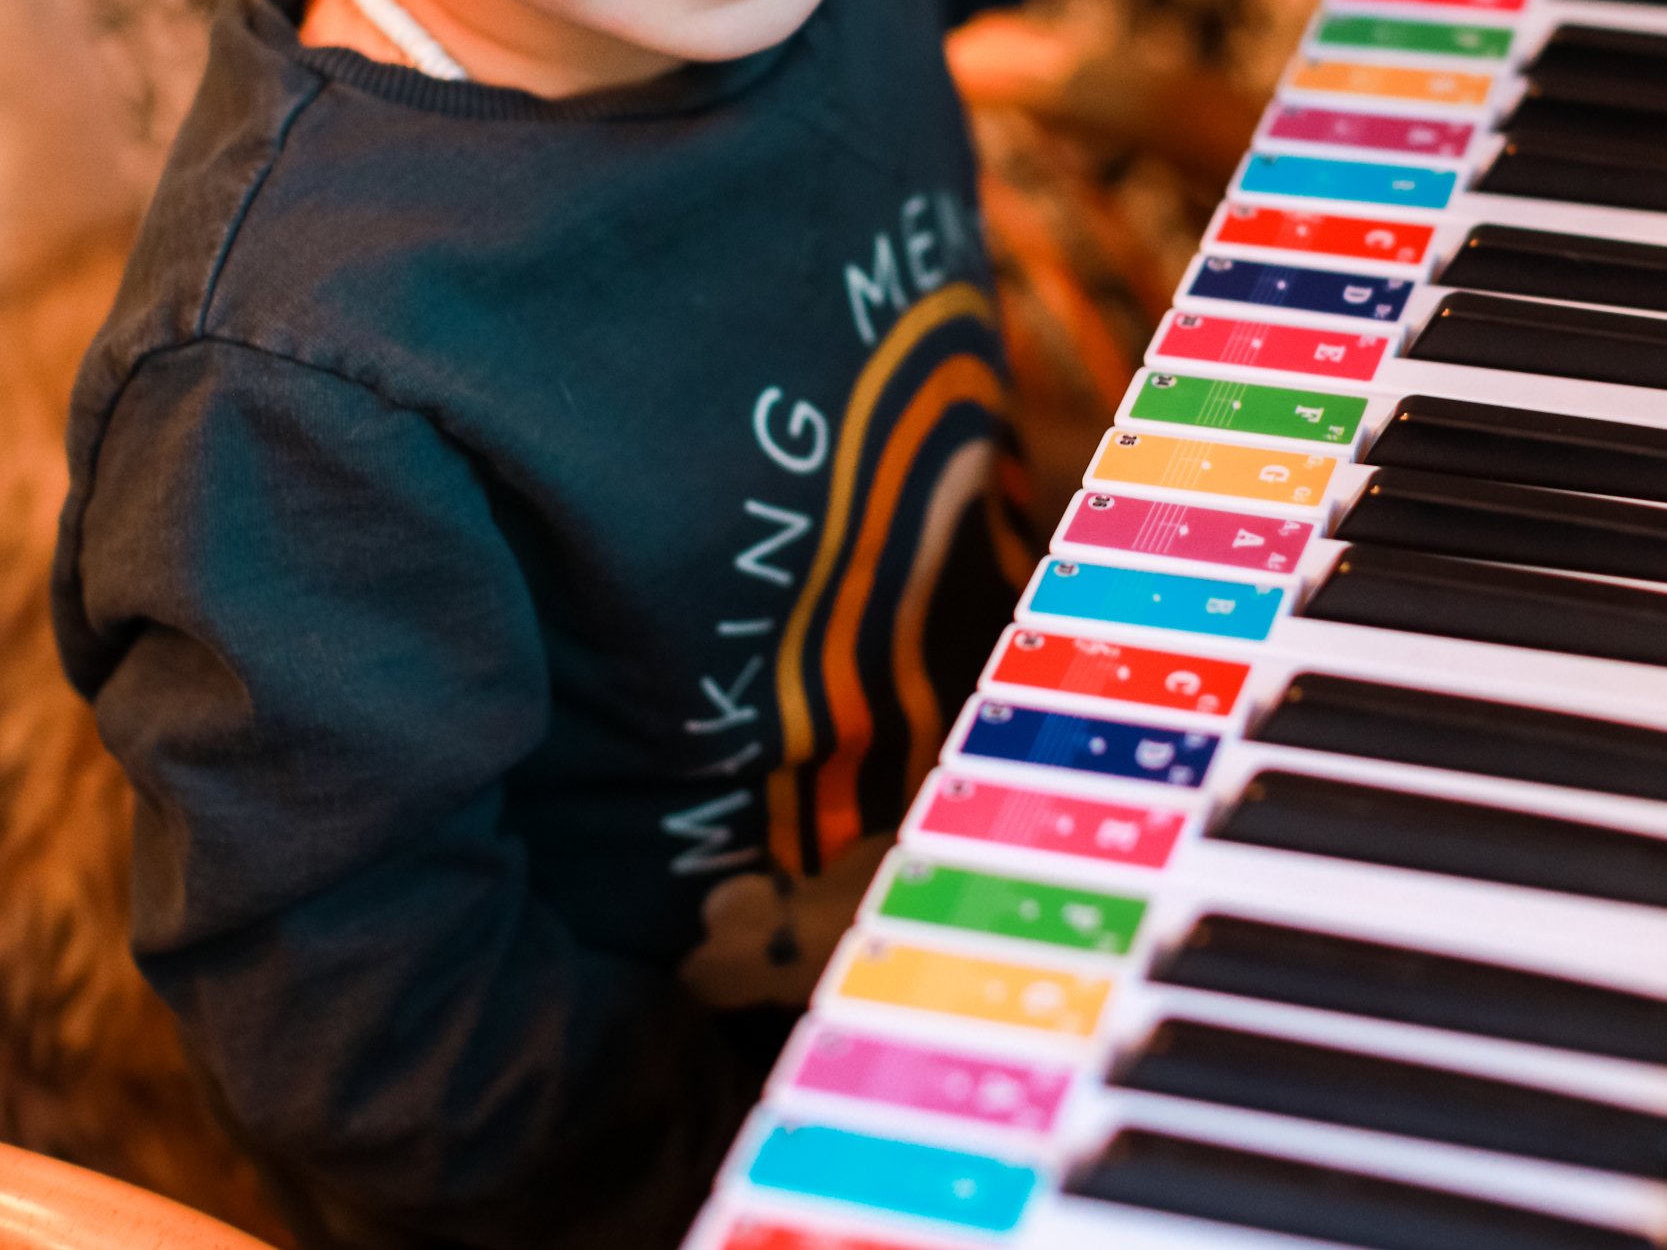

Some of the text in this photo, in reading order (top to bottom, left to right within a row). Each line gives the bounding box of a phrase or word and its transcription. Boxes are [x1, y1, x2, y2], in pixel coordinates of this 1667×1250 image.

[1364, 229, 1395, 250] C
[1342, 284, 1373, 304] D
[1313, 342, 1347, 363] E
[1295, 404, 1325, 423] F
[1259, 464, 1290, 482] G
[1232, 528, 1265, 548] A
[1206, 597, 1237, 615] B
[1165, 670, 1202, 696] C
